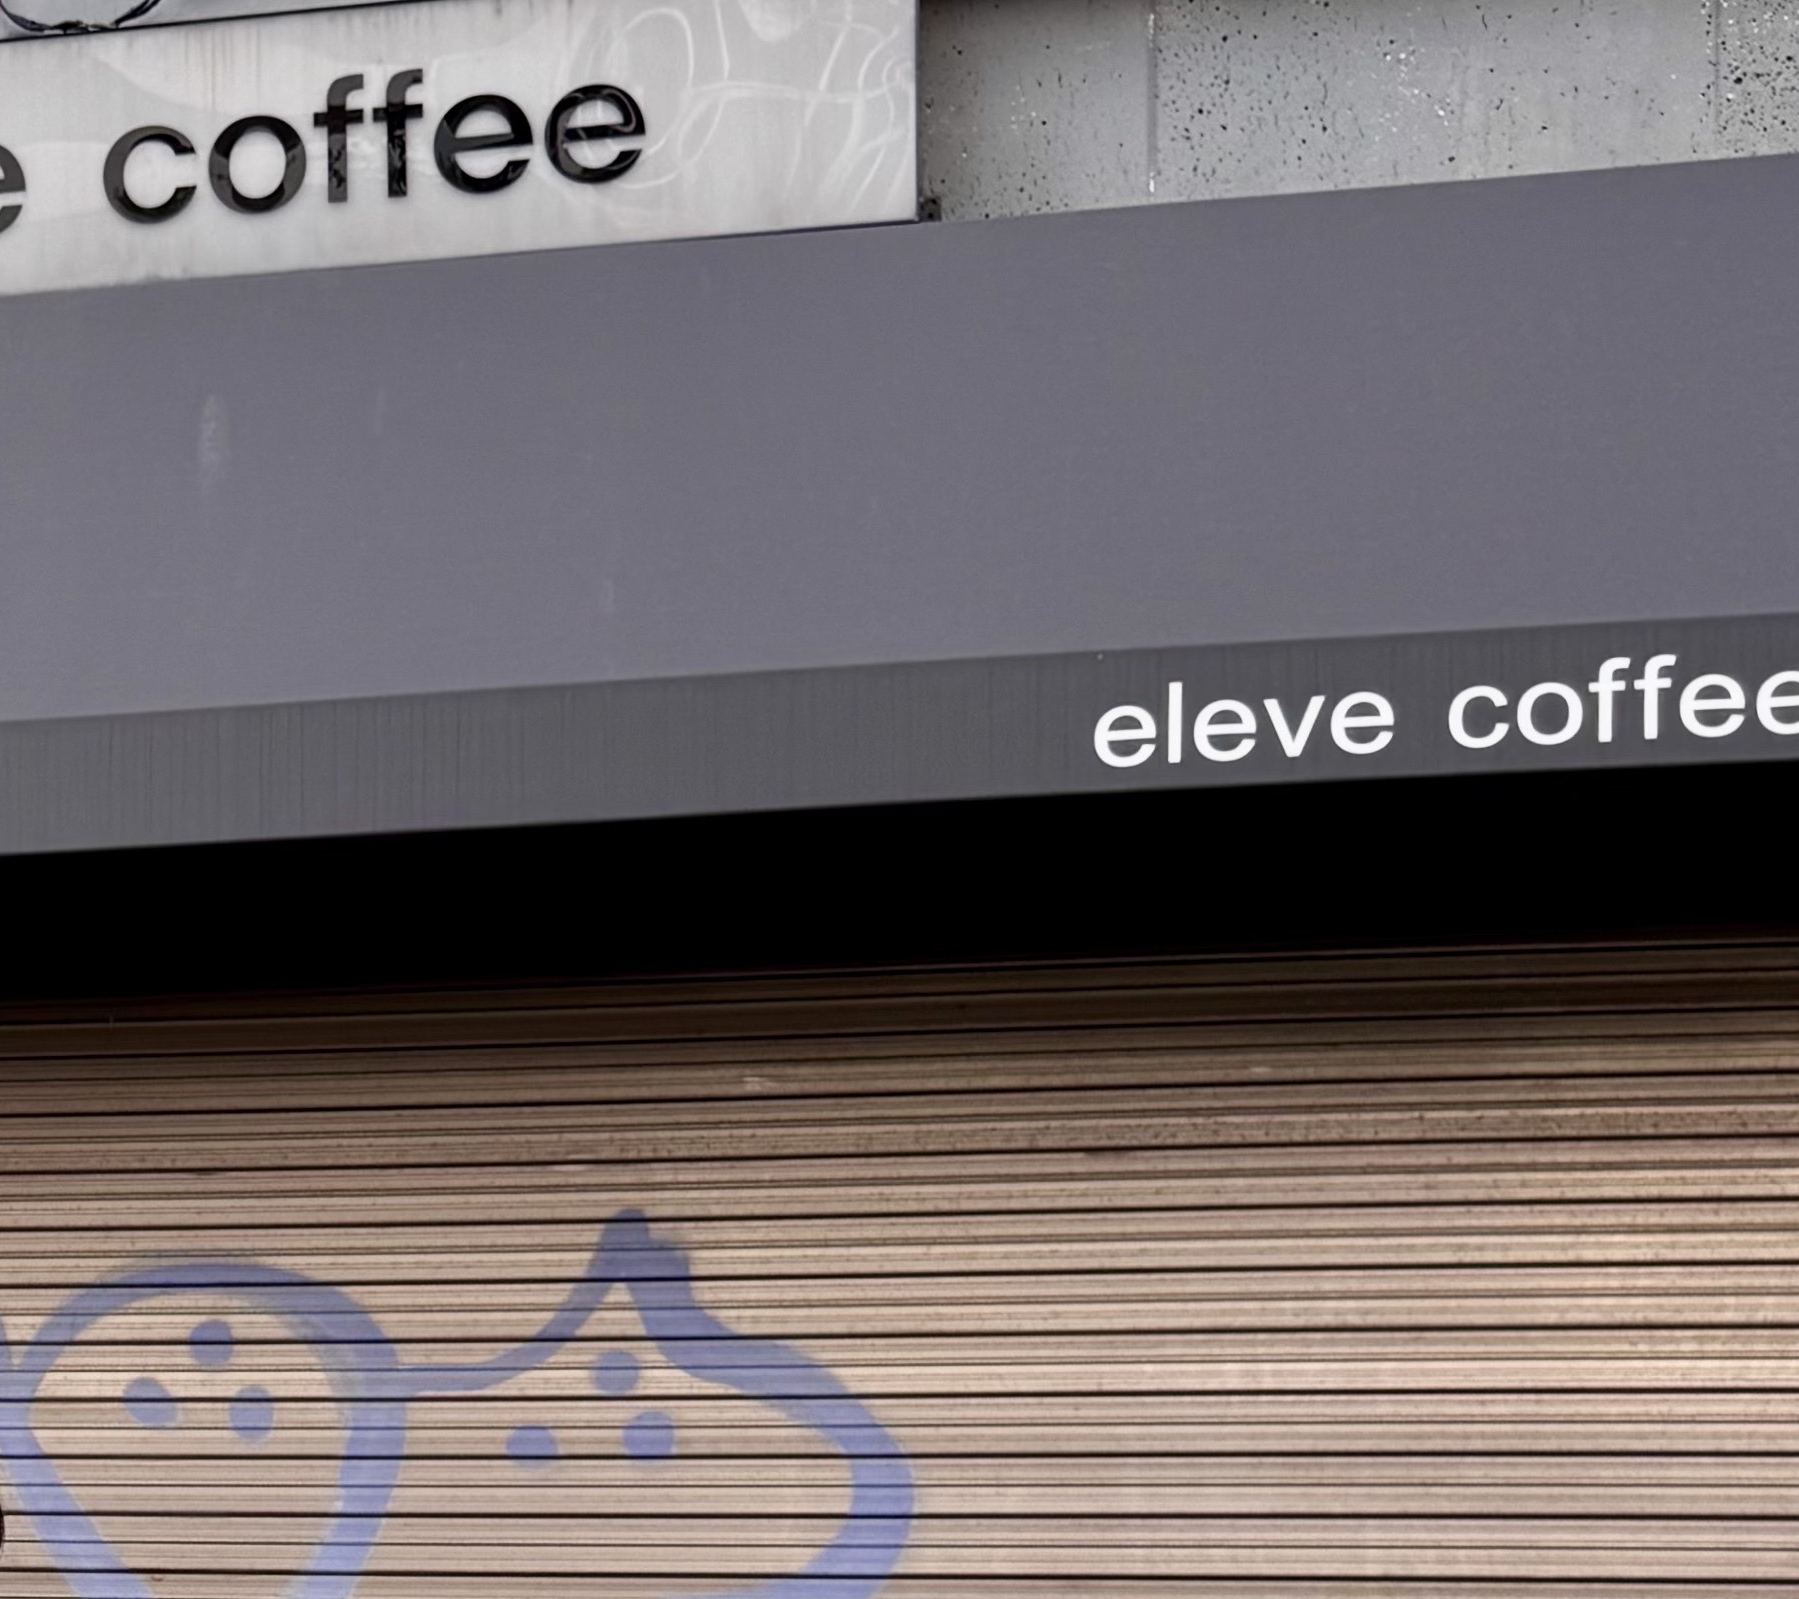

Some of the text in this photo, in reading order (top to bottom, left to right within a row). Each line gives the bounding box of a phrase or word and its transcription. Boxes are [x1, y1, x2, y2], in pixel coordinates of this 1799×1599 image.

[102, 68, 648, 225] coffee
[1092, 653, 1799, 768] eleve coffee
